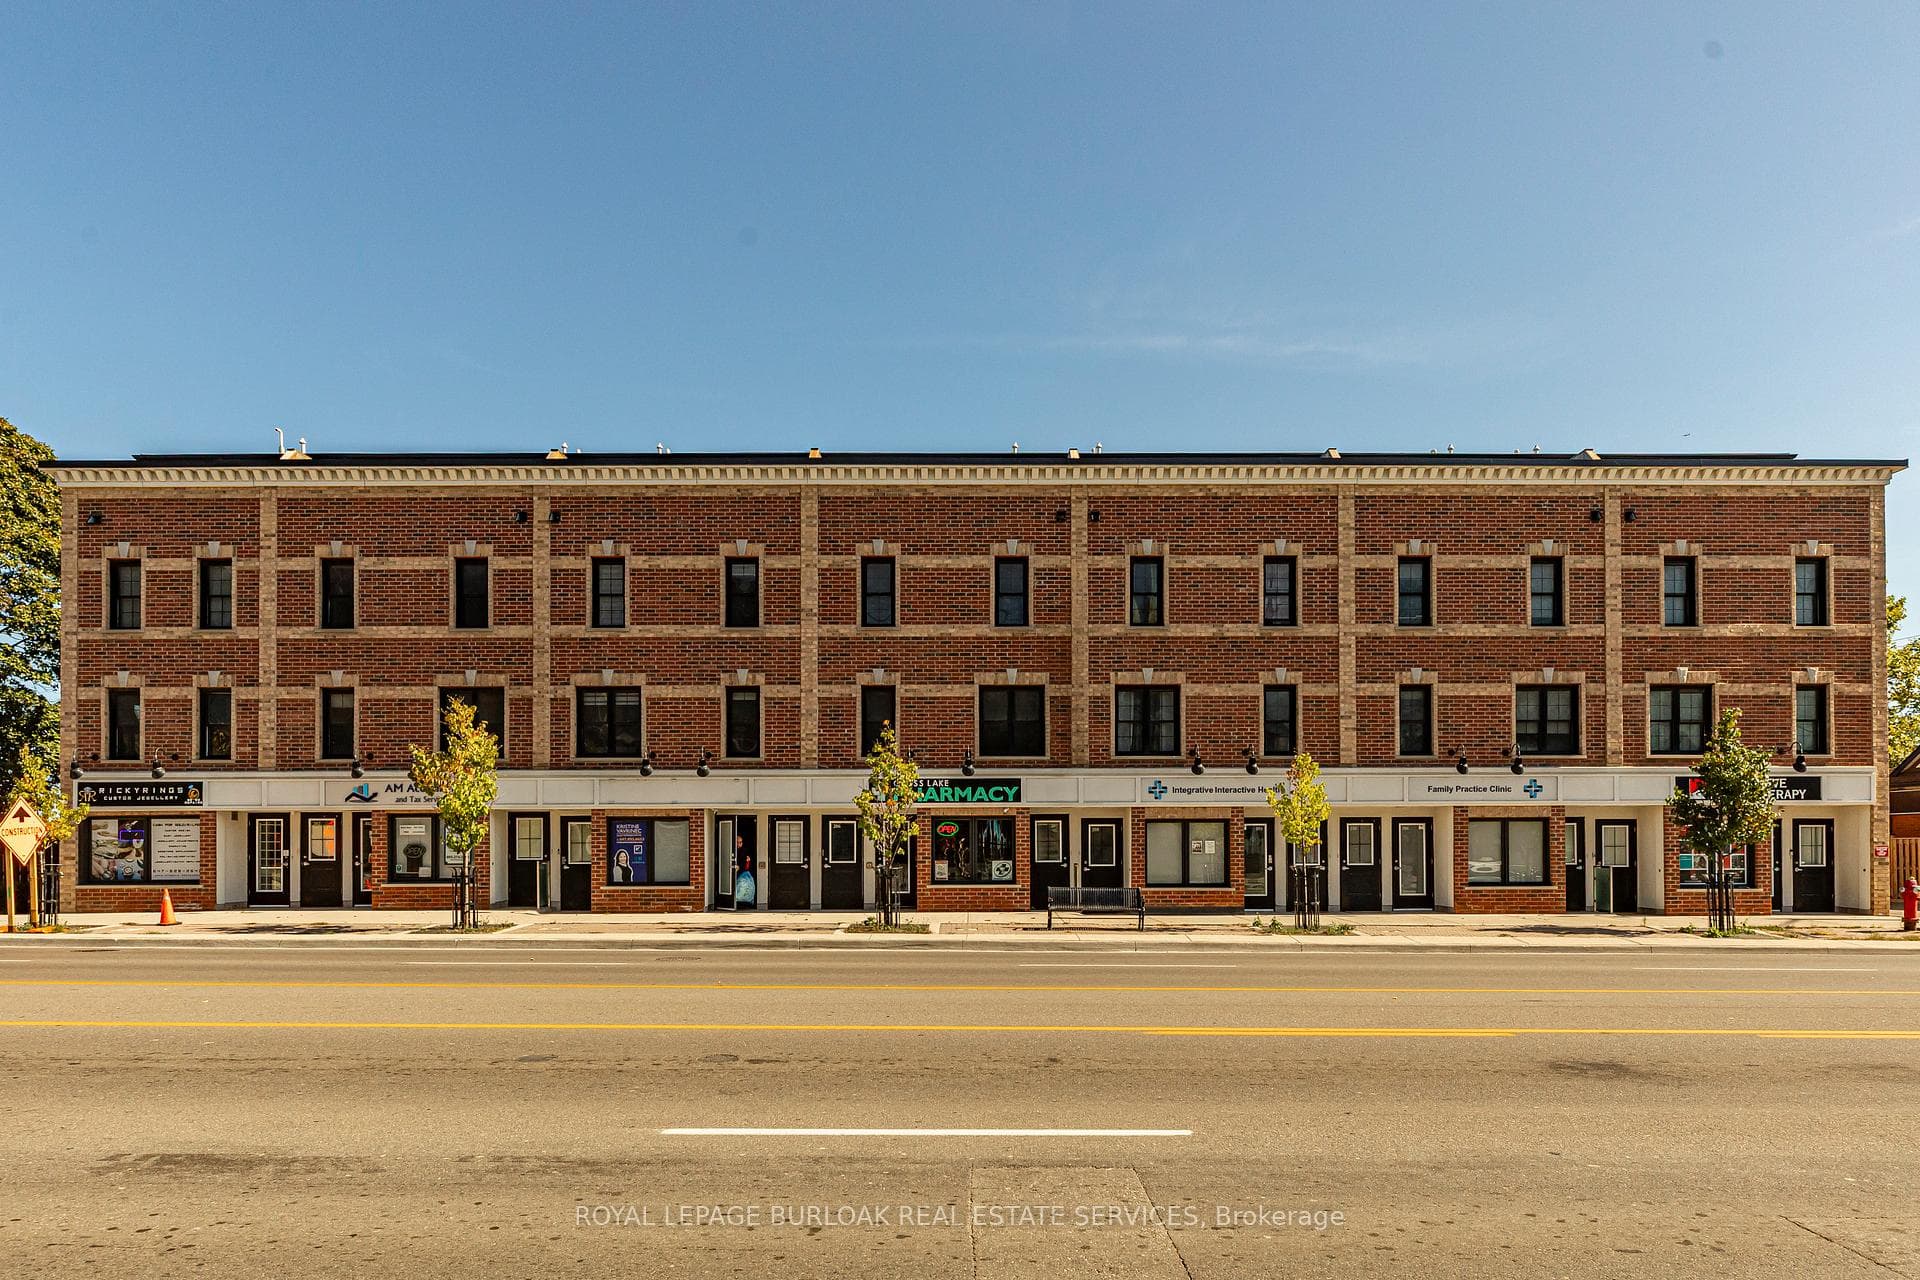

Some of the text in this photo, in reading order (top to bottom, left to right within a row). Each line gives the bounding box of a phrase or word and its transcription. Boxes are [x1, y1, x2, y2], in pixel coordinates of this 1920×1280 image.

[384, 784, 403, 793] AM
[1172, 786, 1213, 795] Integrative
[1427, 785, 1512, 794] Family Practice Clinic
[395, 795, 408, 803] and
[410, 795, 421, 803] Tax
[937, 825, 957, 834] OPEN
